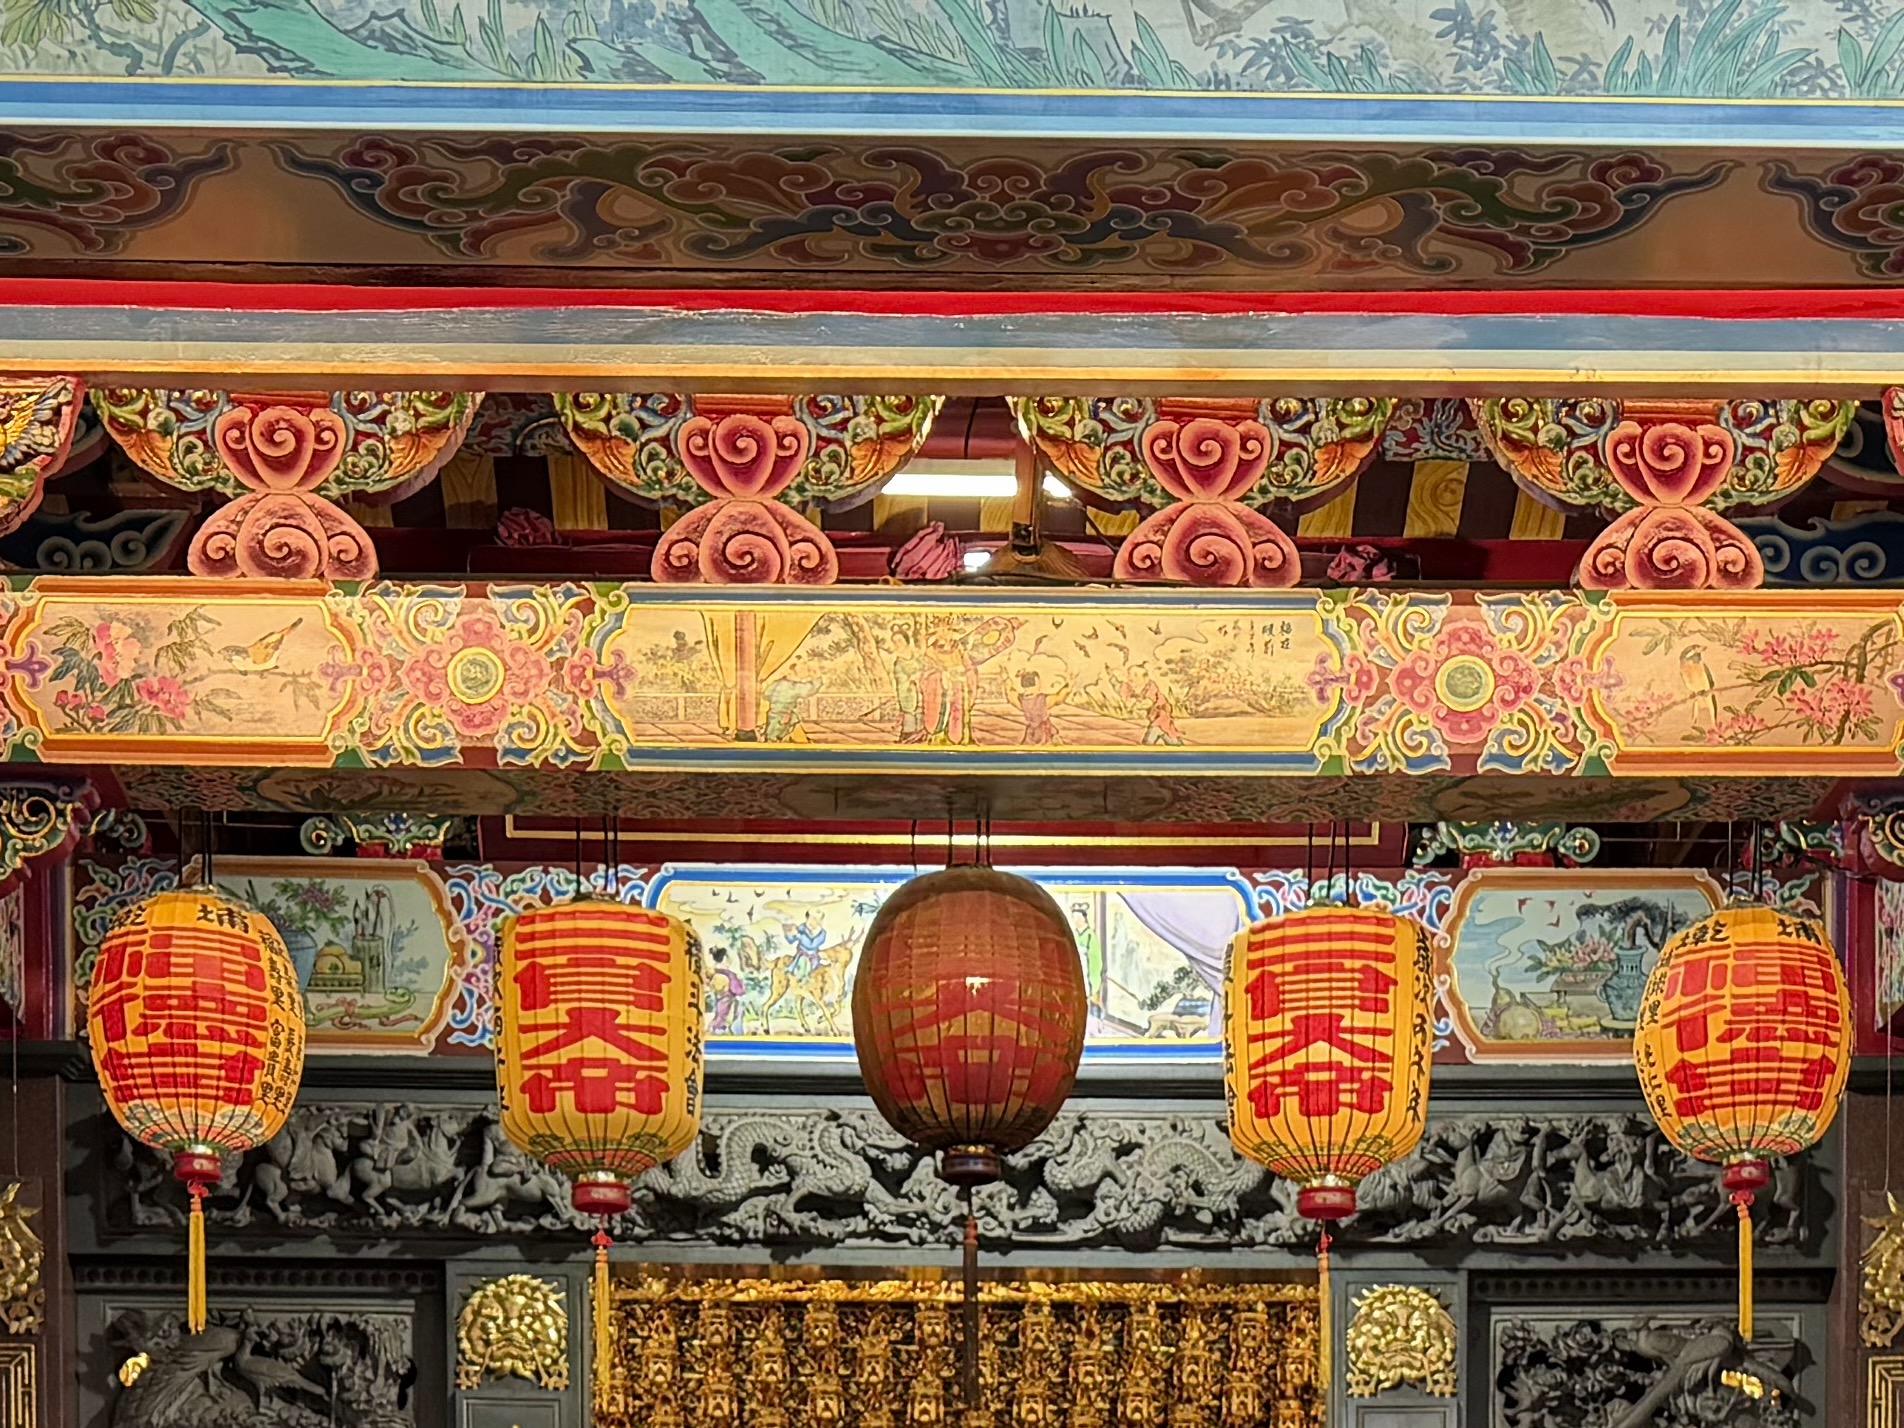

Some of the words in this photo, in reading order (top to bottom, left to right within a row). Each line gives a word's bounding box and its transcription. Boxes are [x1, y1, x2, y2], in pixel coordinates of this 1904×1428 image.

[513, 909, 672, 1115] 三官大帝
[1244, 914, 1399, 1119] 三官大帝
